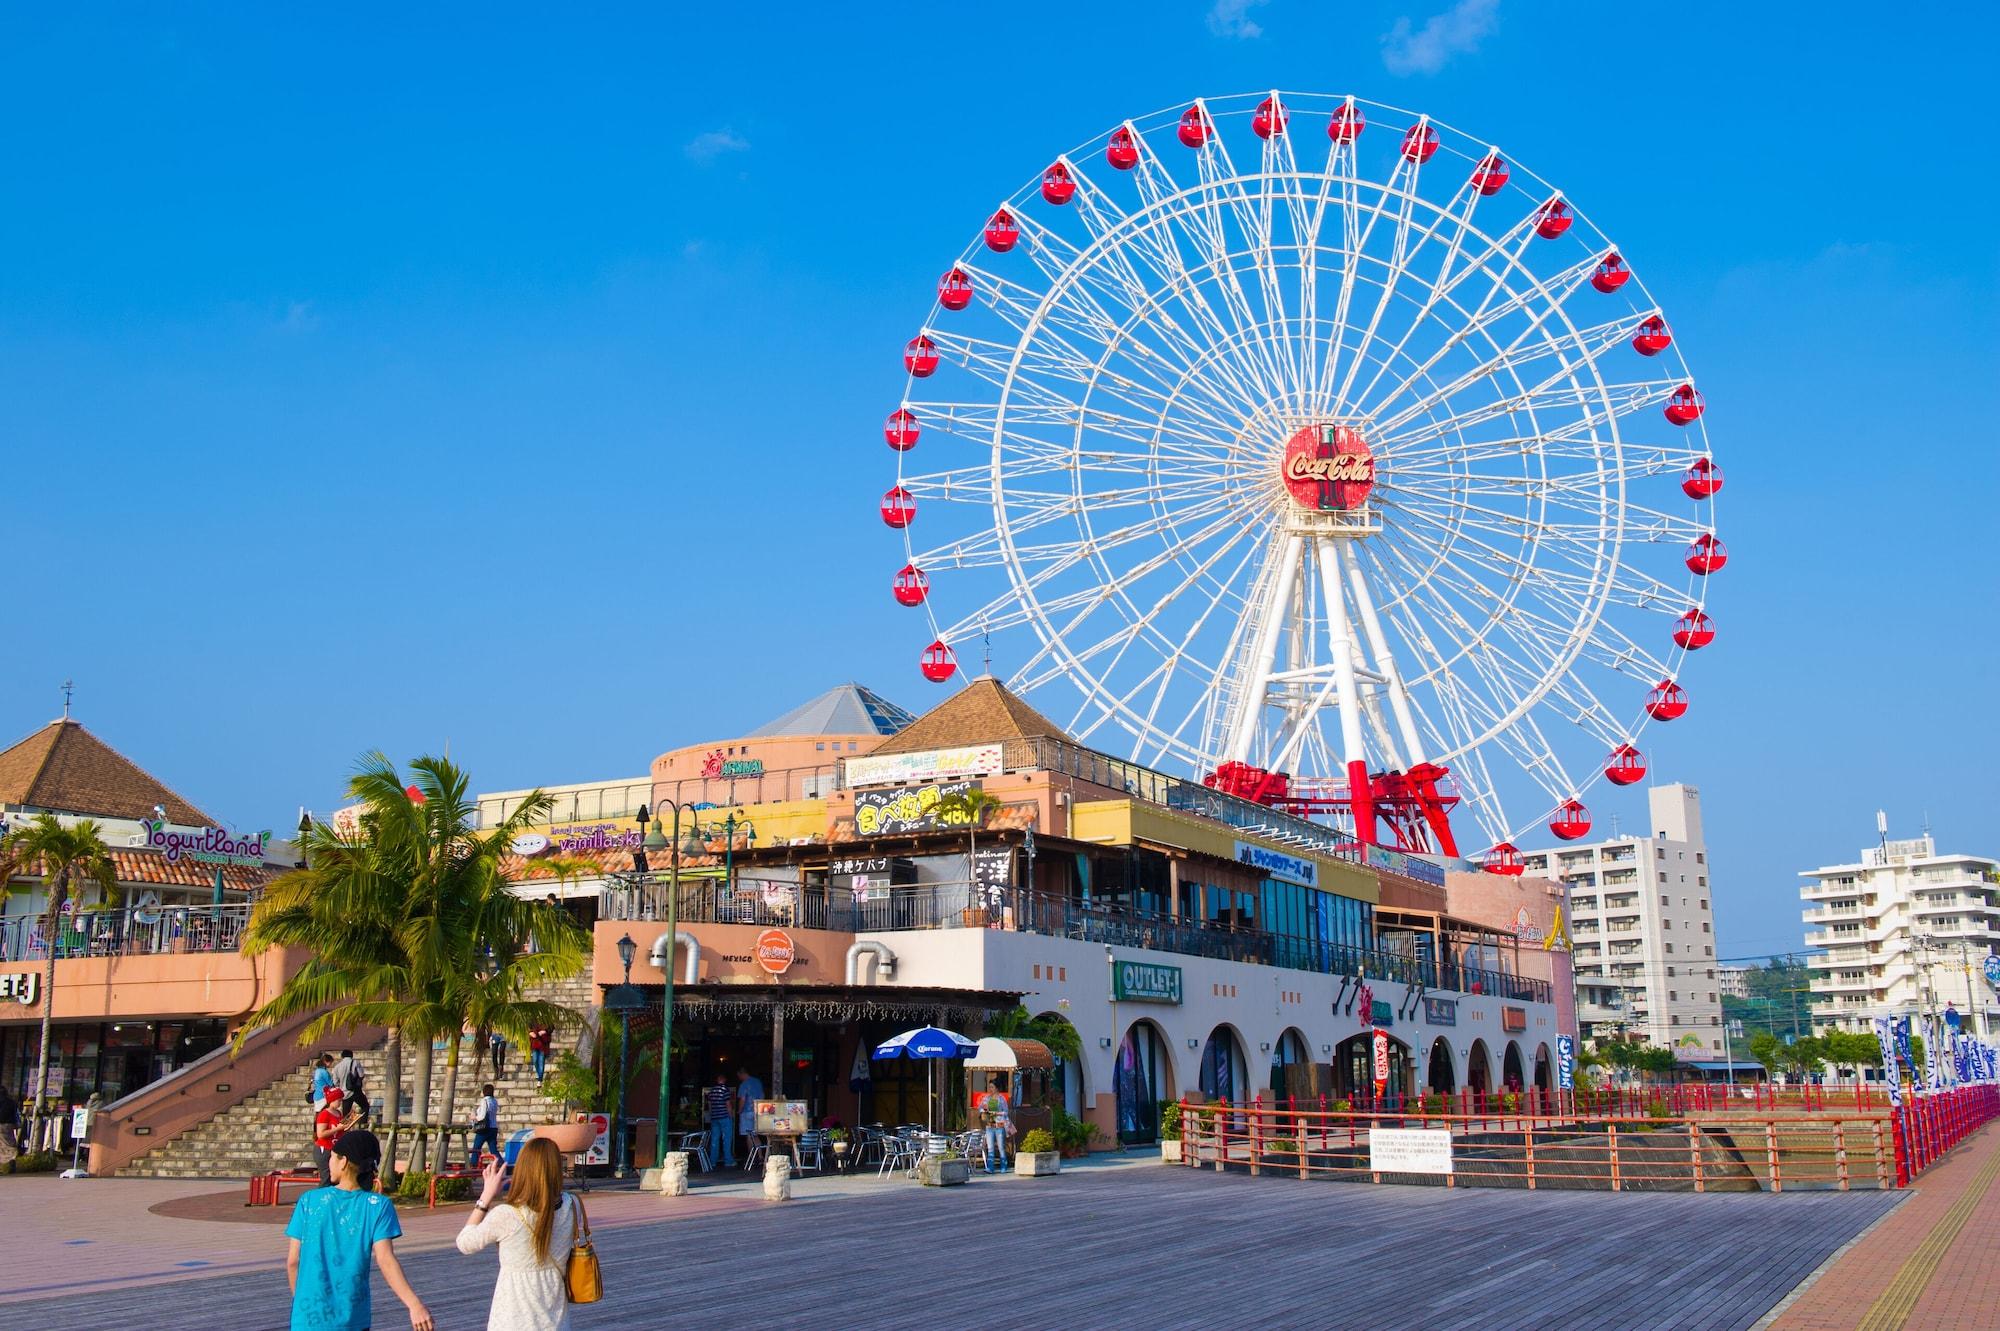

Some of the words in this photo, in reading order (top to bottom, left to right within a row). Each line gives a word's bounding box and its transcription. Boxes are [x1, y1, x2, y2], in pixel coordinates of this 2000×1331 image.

[1287, 451, 1372, 480] Coca-Cola
[140, 819, 264, 861] Yogurtland
[559, 830, 613, 850] vanilla
[195, 853, 229, 864] FROZEN
[832, 857, 887, 874] 沖縄ケバブ
[722, 955, 752, 963] MEXICO
[1123, 964, 1180, 1001] OUTLET-J
[917, 1045, 943, 1053] Corona
